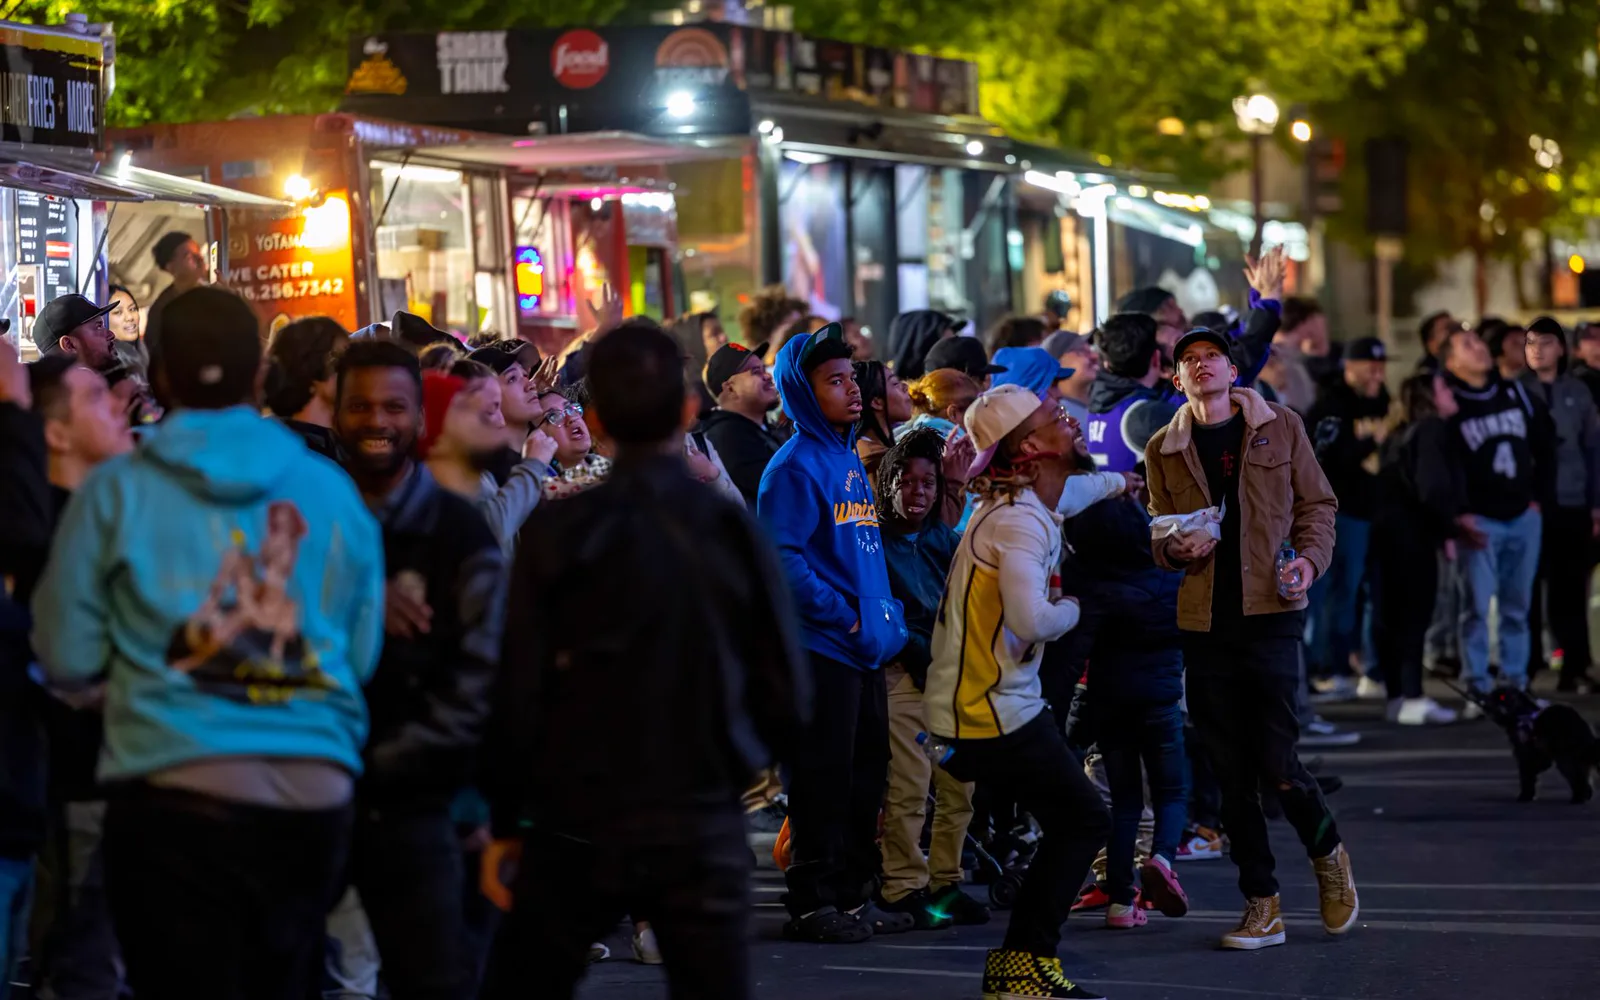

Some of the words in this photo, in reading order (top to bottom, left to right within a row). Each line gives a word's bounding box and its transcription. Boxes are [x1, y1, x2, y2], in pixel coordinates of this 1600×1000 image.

[438, 60, 510, 94] TANK
[553, 42, 609, 77] food
[27, 73, 56, 130] FRIES
[256, 261, 315, 281] CATER
[1492, 440, 1518, 479] 4
